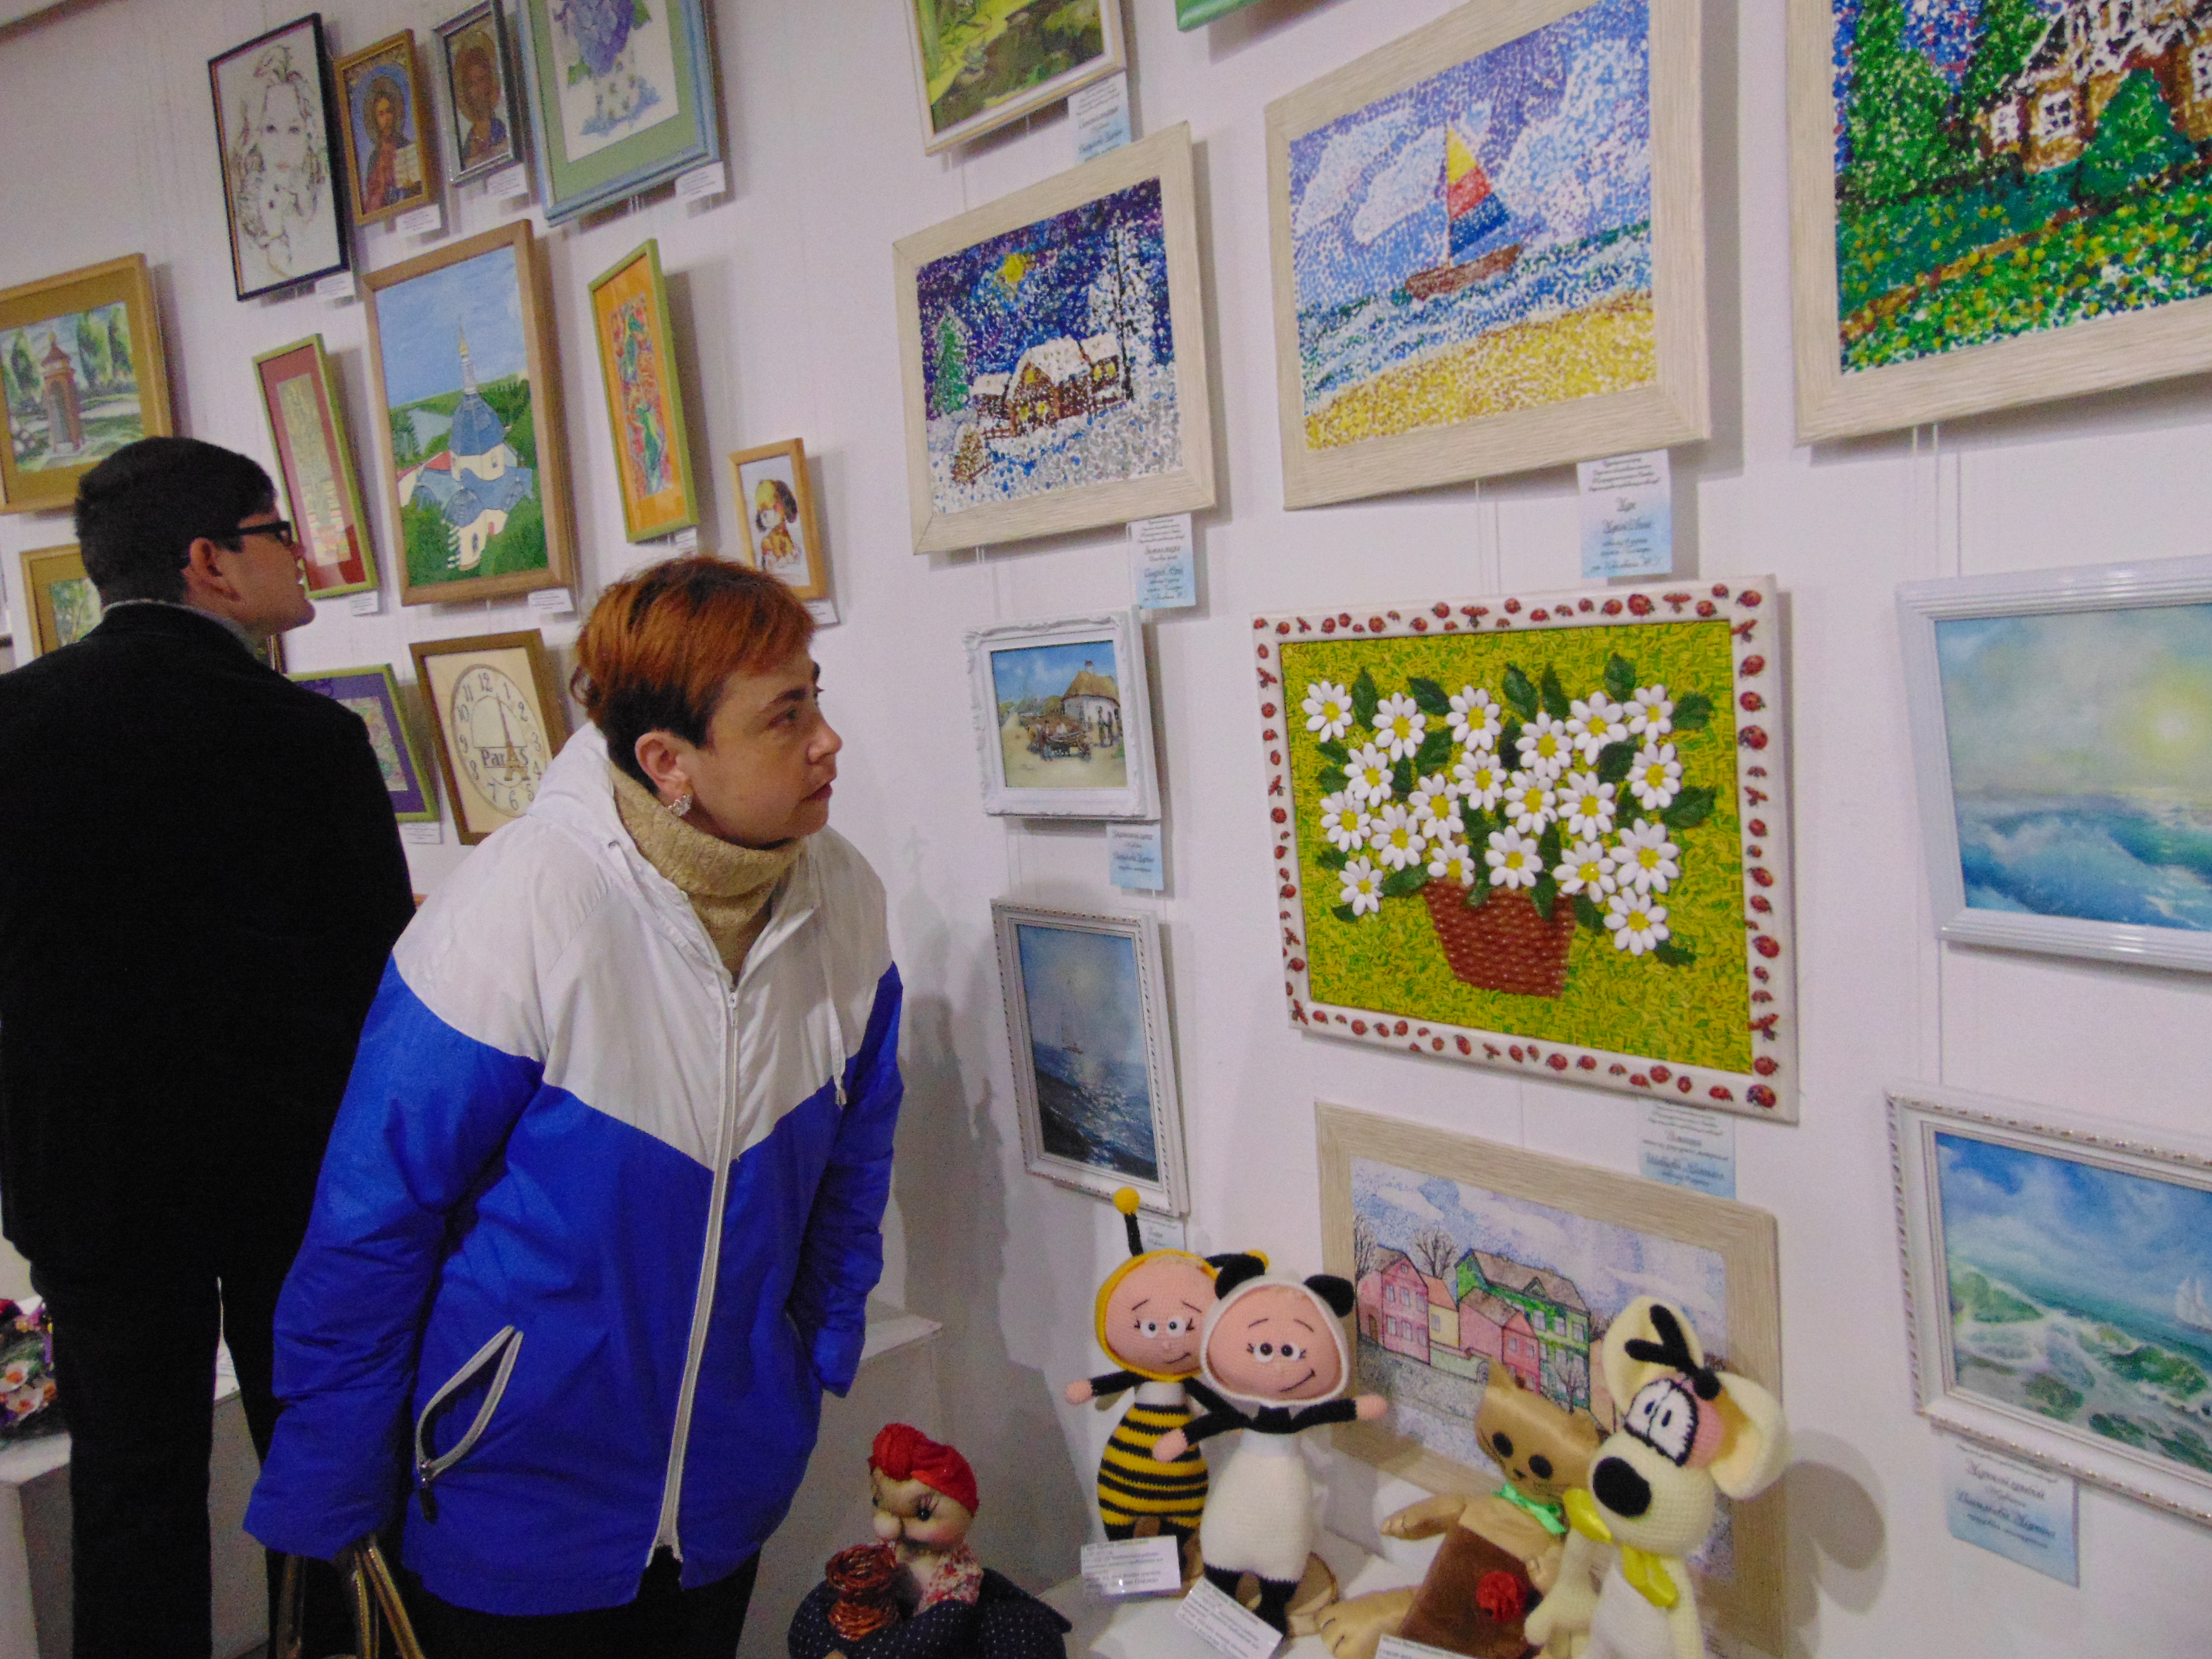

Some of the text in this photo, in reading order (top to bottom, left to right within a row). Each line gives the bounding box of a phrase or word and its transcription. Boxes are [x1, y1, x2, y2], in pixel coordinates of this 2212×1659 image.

[478, 672, 492, 692] 12
[503, 682, 510, 700] 1
[463, 684, 474, 702] 11
[518, 702, 529, 722] 2
[459, 734, 468, 753] 9
[532, 732, 541, 752] 3
[470, 760, 480, 780] 8
[533, 760, 542, 781] 4
[487, 782, 496, 802] 7
[508, 790, 519, 811] 6
[526, 783, 535, 802] 5
